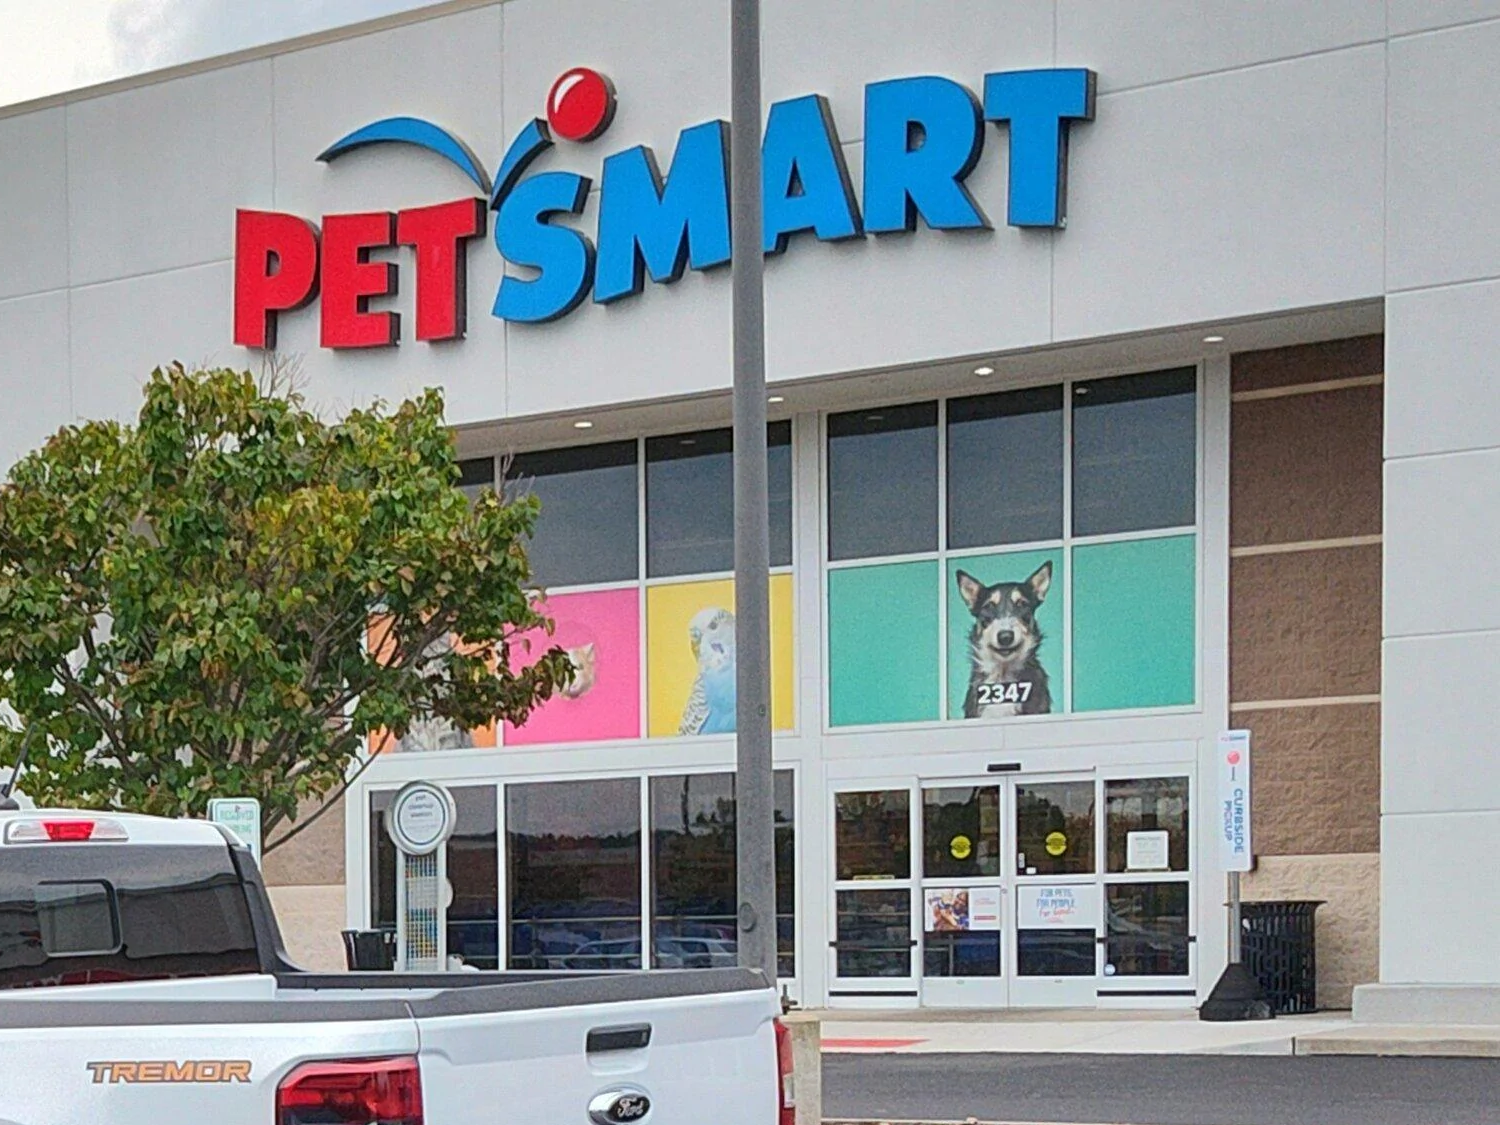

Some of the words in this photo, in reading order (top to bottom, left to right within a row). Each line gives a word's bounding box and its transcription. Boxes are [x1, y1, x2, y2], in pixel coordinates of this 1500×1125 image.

[977, 682, 1032, 704] 2347
[1223, 800, 1233, 841] PICKUP
[1234, 788, 1244, 853] CURBSIDE
[86, 1060, 252, 1084] TREMOR
[617, 1096, 645, 1118] Ford
